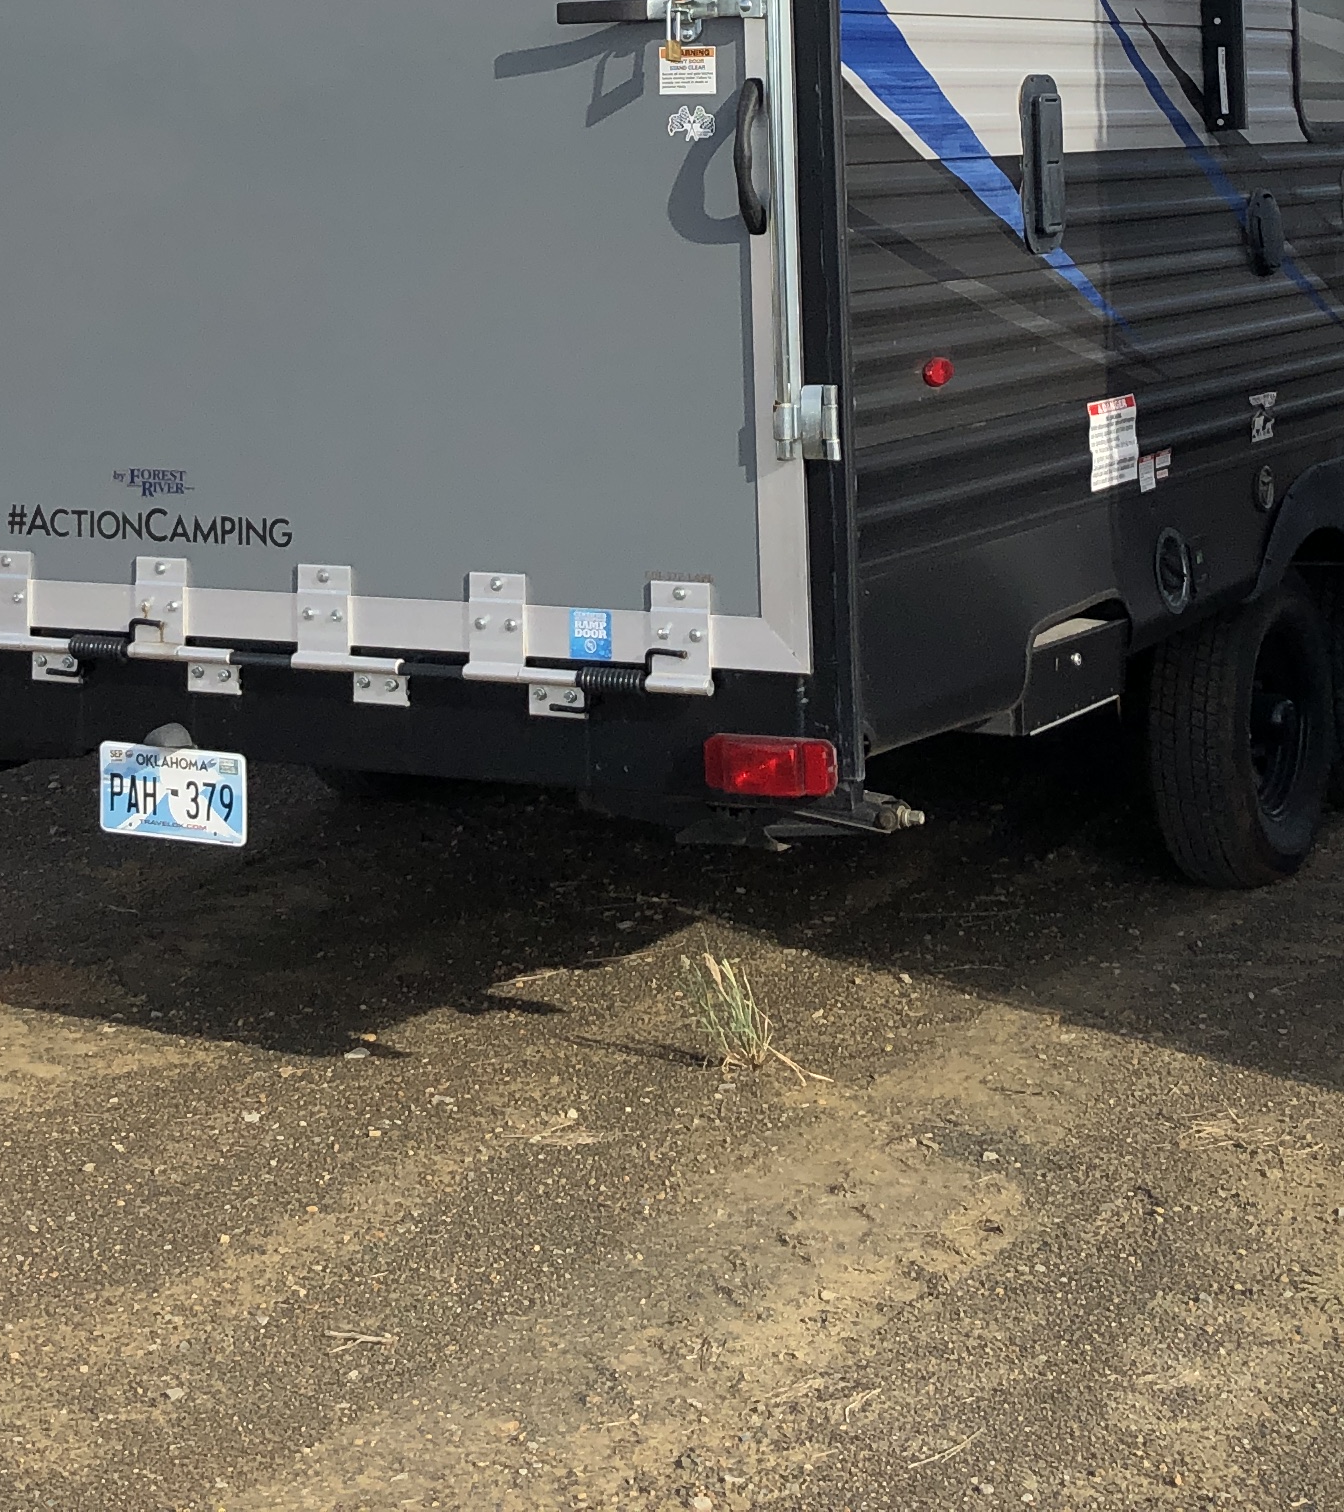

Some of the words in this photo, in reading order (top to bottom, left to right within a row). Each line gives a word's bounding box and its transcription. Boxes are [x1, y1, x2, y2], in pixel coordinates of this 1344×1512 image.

[113, 470, 126, 482] by
[129, 468, 186, 484] FOREST
[141, 480, 184, 497] RIVER
[574, 620, 607, 629] RAMP
[574, 629, 607, 639] DOOR
[136, 753, 208, 772] OKLAHOMA
